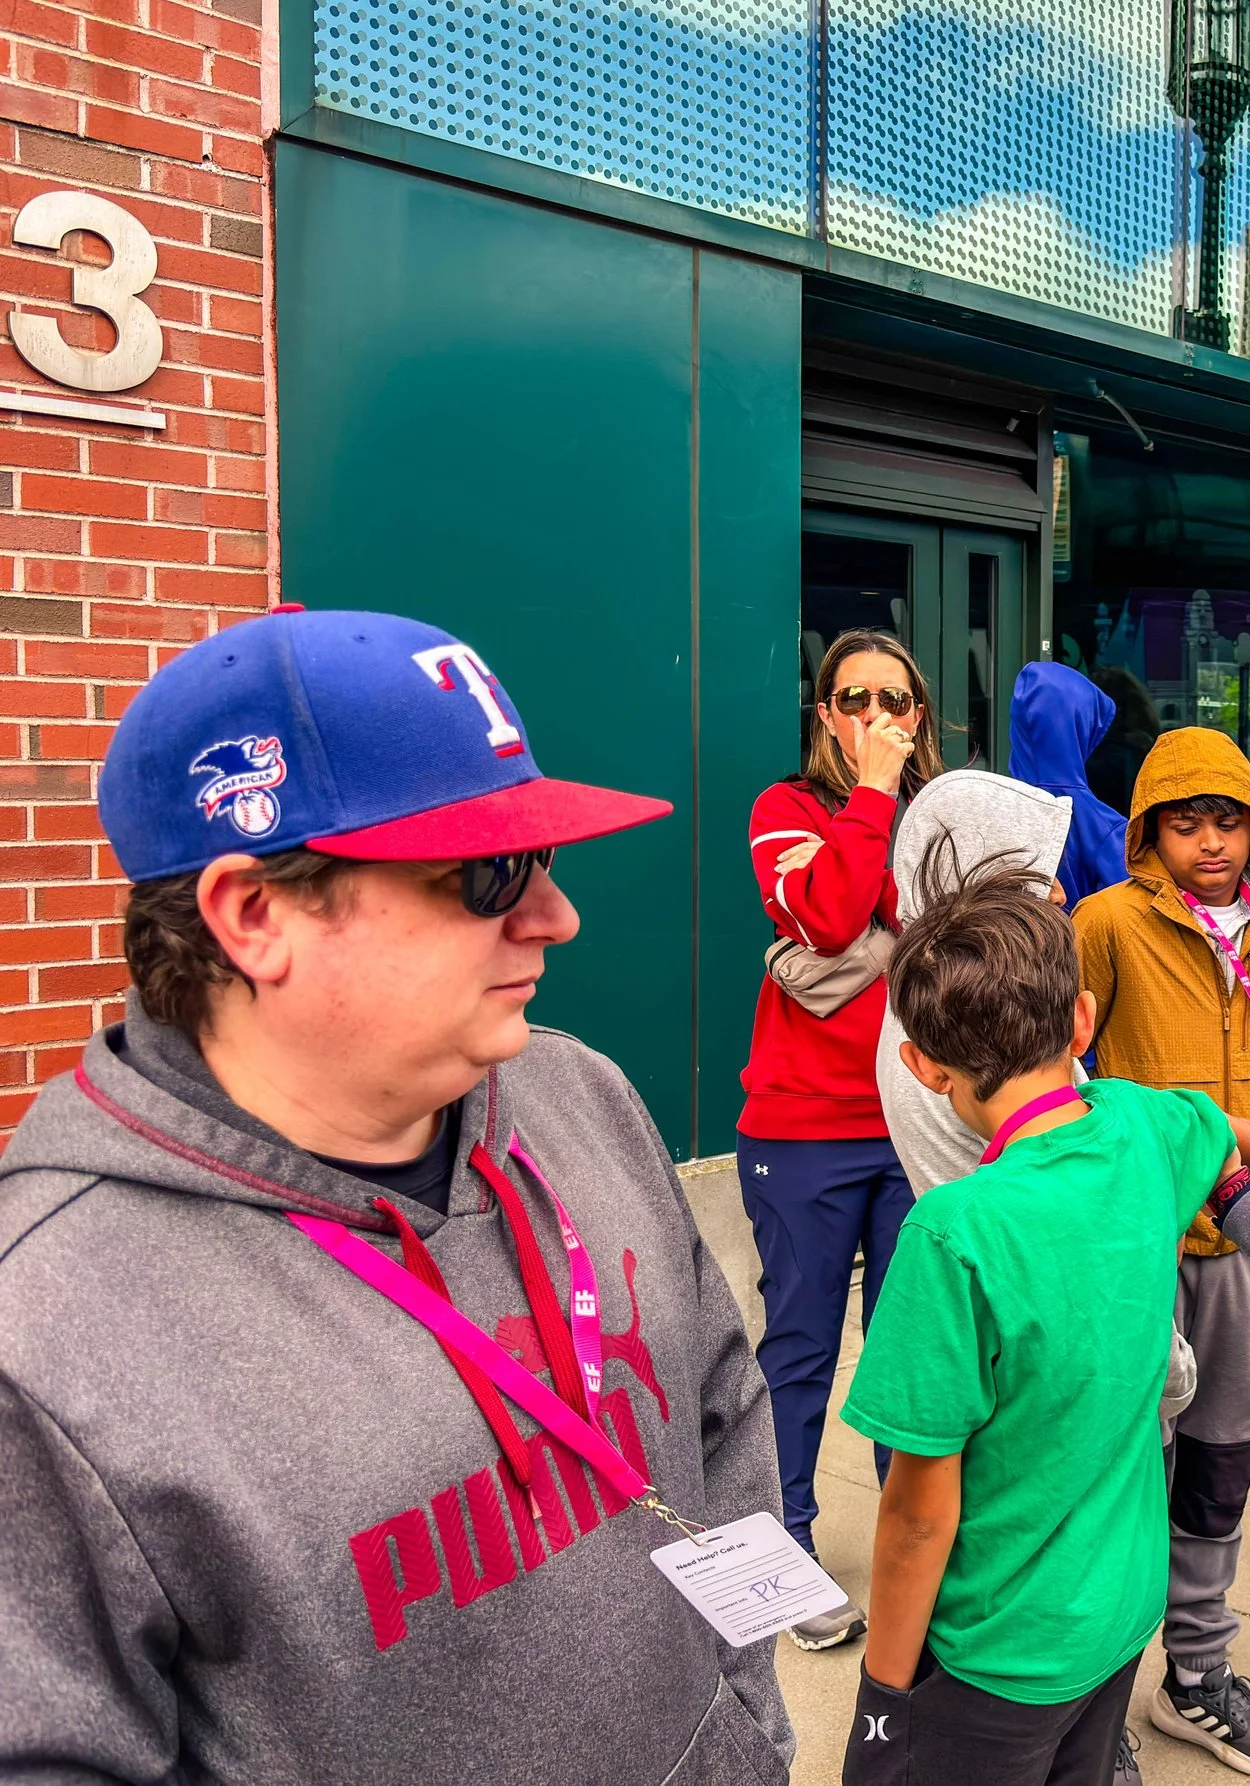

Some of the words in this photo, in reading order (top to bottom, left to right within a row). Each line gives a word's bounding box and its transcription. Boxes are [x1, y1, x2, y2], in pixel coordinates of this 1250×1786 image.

[9, 190, 163, 392] 3
[412, 644, 524, 758] T
[215, 771, 273, 795] AMERICAN
[1193, 904, 1206, 915] EF
[1213, 927, 1224, 937] EF
[1228, 950, 1239, 962] EF
[1240, 976, 1250, 988] EF
[575, 1290, 596, 1317] EF
[584, 1362, 601, 1392] EF
[676, 1559, 697, 1570] Need
[697, 1551, 719, 1562] Help?
[720, 1545, 735, 1554] Call
[750, 1575, 797, 1602] PK
